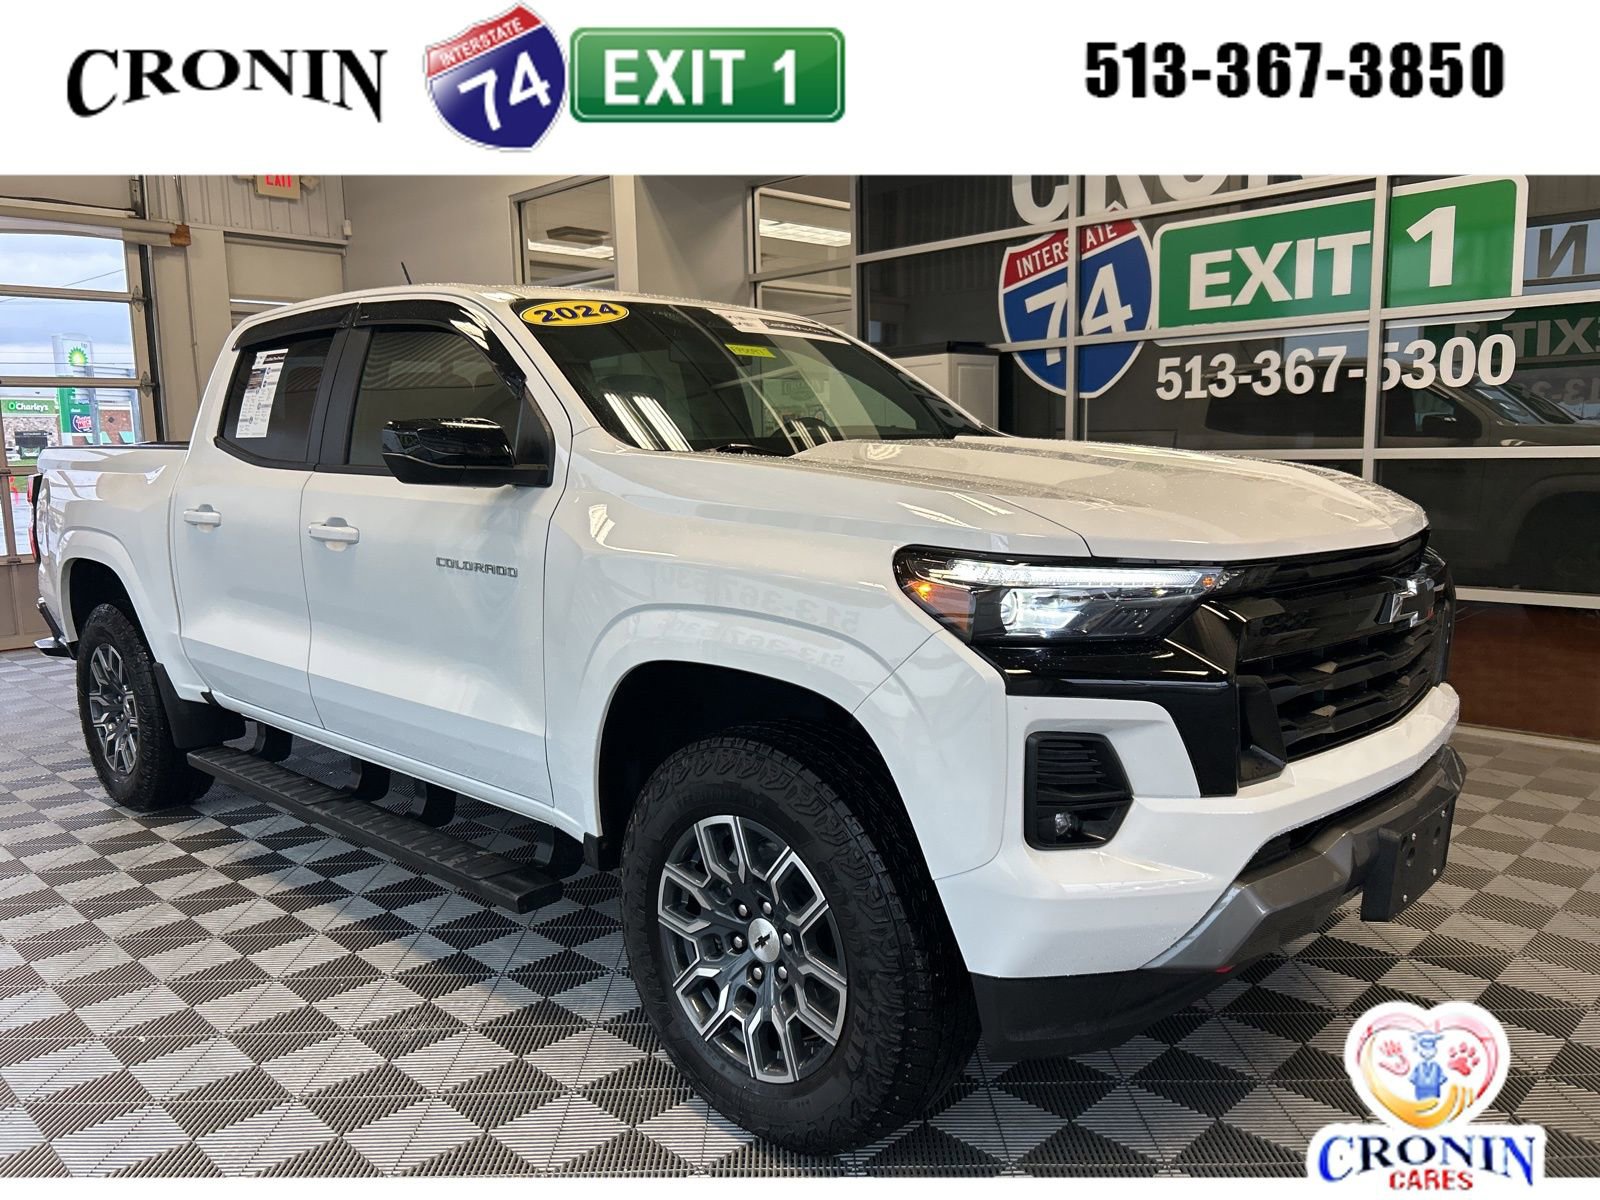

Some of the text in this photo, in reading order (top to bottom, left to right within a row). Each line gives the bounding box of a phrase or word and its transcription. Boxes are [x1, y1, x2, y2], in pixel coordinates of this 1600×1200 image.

[1016, 223, 1119, 279] INTERSATE
[1189, 205, 1457, 311] EXIT 1
[533, 303, 620, 323] 2024
[1024, 263, 1134, 367] 74
[1155, 333, 1517, 401] 513-367-5300
[435, 556, 519, 578] COLORADO
